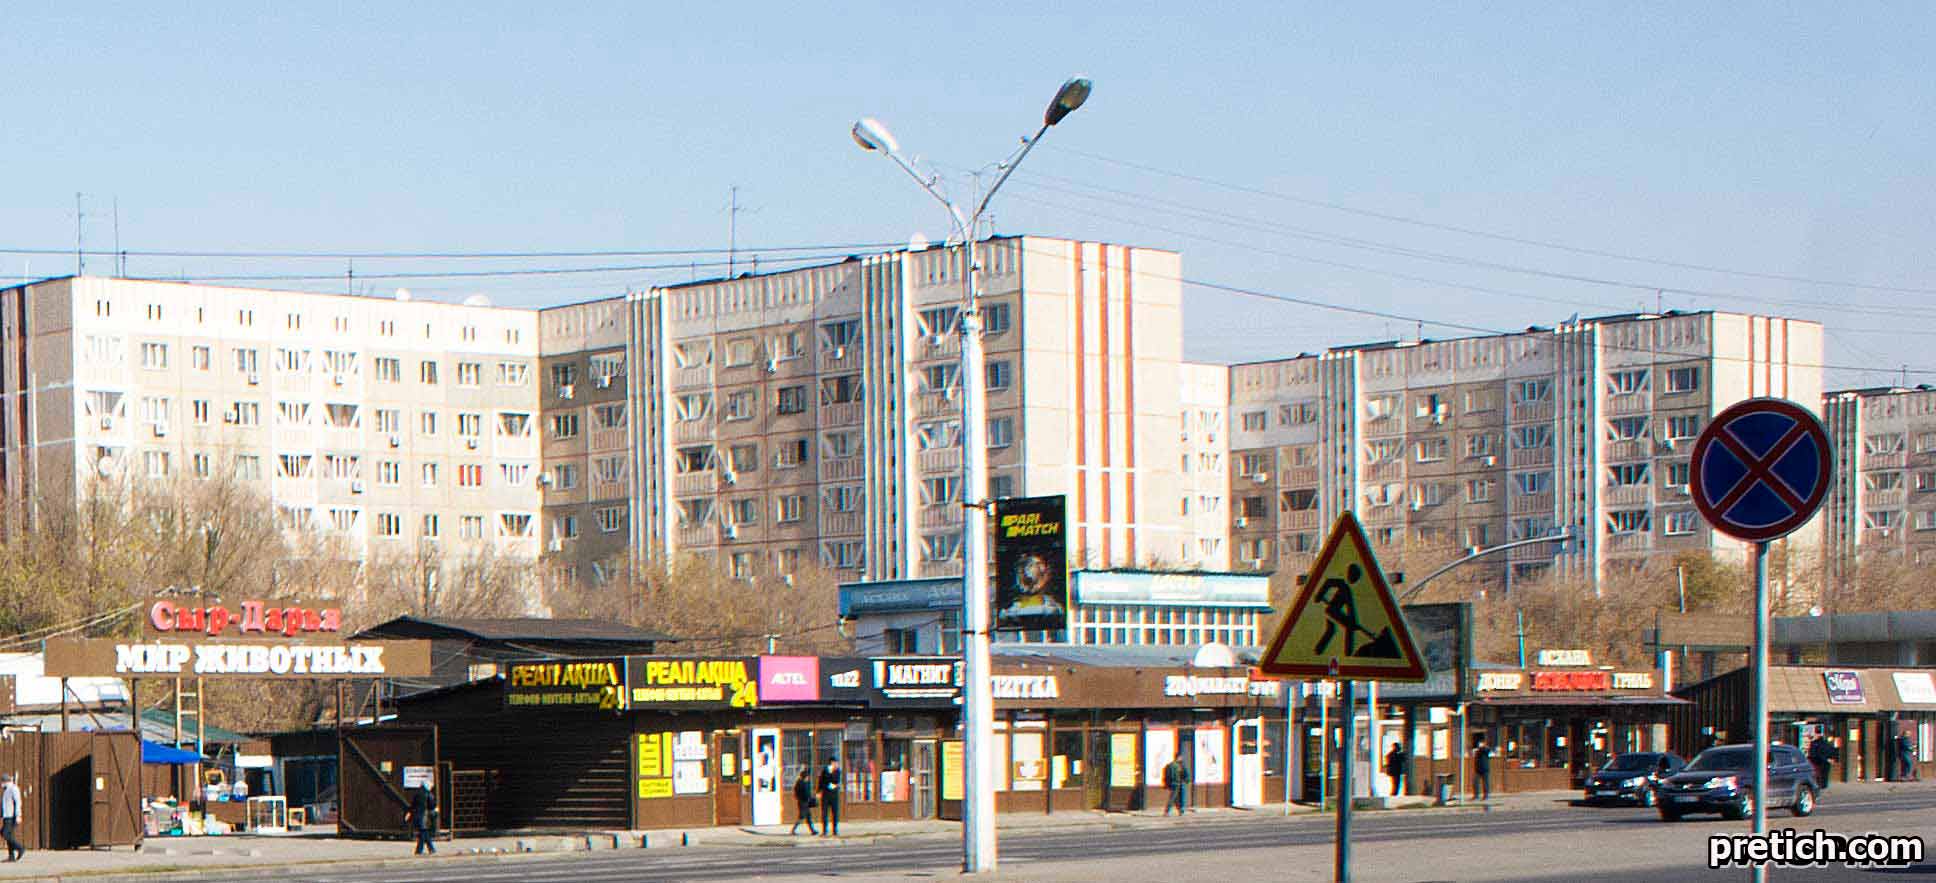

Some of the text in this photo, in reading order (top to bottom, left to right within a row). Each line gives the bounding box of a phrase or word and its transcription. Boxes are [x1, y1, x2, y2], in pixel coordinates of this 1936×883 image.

[1006, 513, 1041, 526] PARI
[1010, 522, 1060, 537] MATCH
[151, 601, 341, 636] Сыр-Дарья
[115, 644, 385, 674] МИР ЖИВОТНЫХ
[646, 661, 695, 684] РЕАЛ
[888, 664, 952, 684] МАГНИТ
[730, 681, 758, 707] 24
